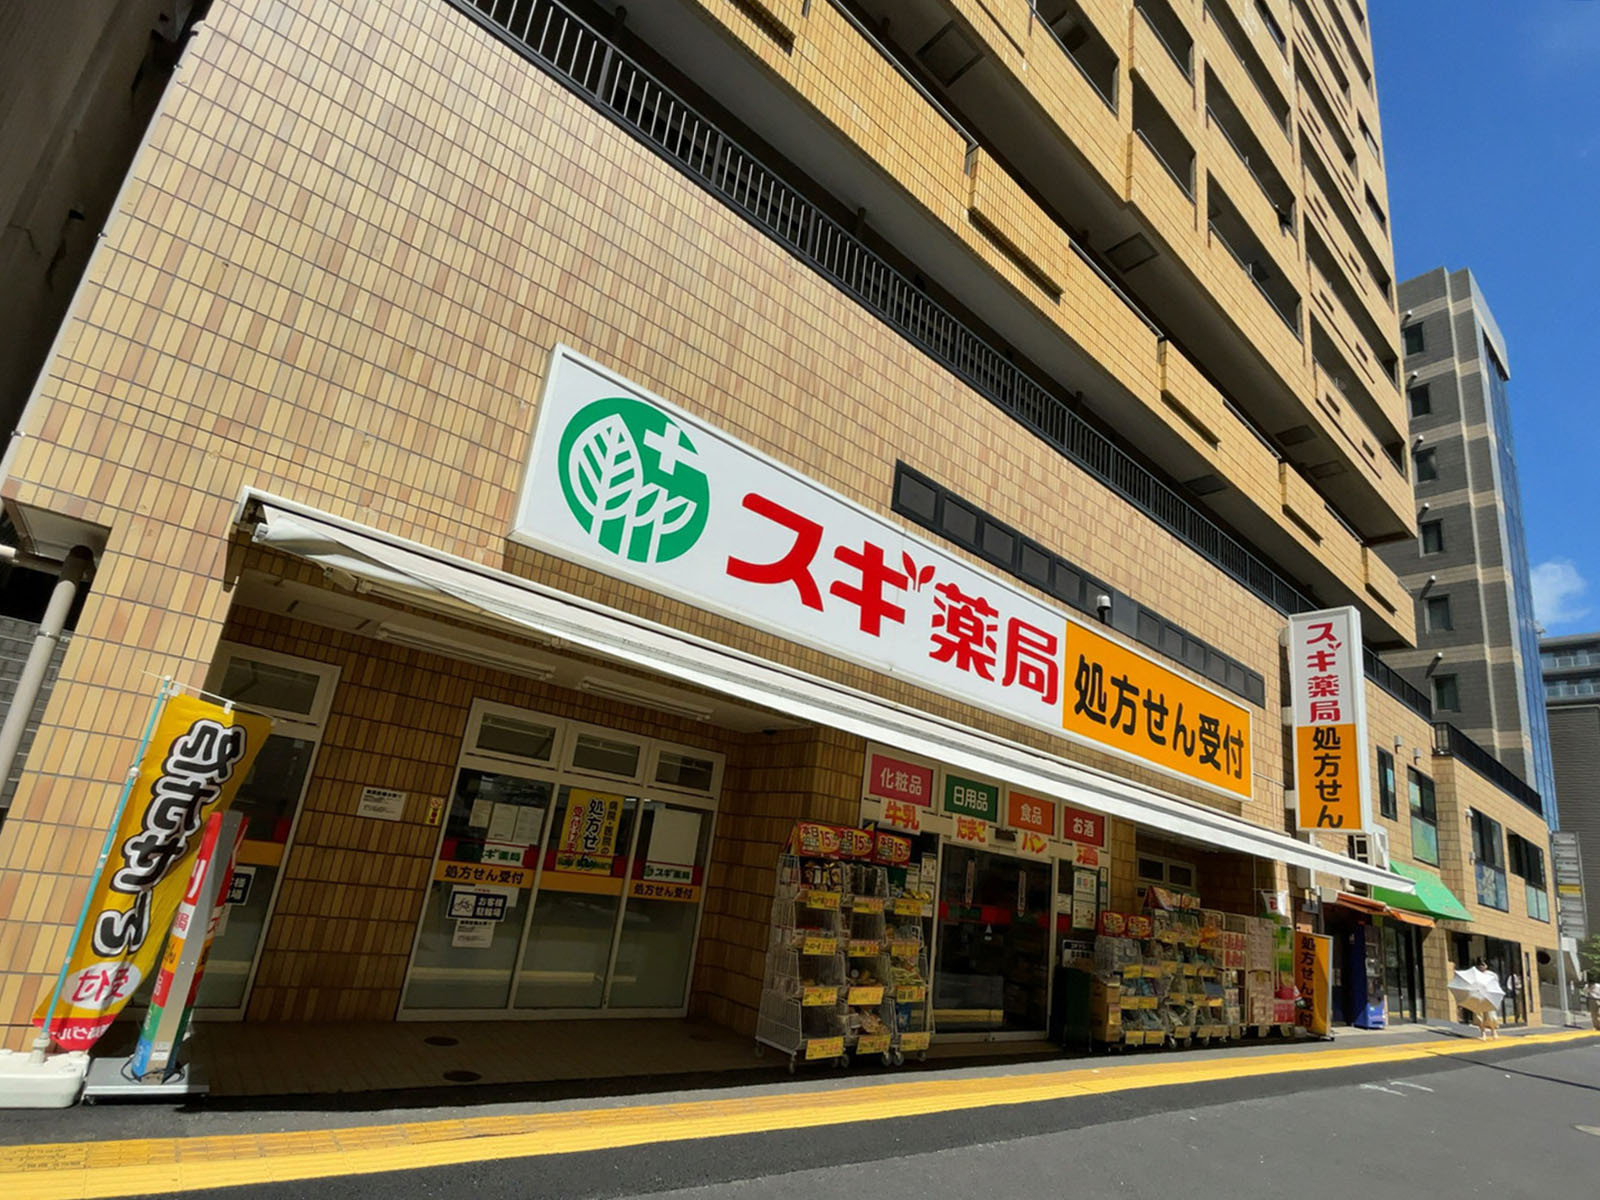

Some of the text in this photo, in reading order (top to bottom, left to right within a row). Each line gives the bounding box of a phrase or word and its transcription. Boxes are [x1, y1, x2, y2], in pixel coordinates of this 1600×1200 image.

[726, 492, 1059, 704] スギ薬局
[1306, 622, 1342, 723] スギ薬局
[1073, 653, 1245, 780] 処方せん受付
[880, 767, 922, 796] 化粧品
[1312, 727, 1343, 829] 処方せん
[953, 785, 988, 812] 日用品
[885, 800, 919, 830] 牛乳
[1020, 802, 1043, 825] 食品
[955, 816, 987, 842] たまご
[1073, 817, 1094, 838] お酒
[1021, 833, 1048, 854] パン
[444, 865, 524, 885] 処方せん受付
[633, 883, 693, 899] 処方せん受付
